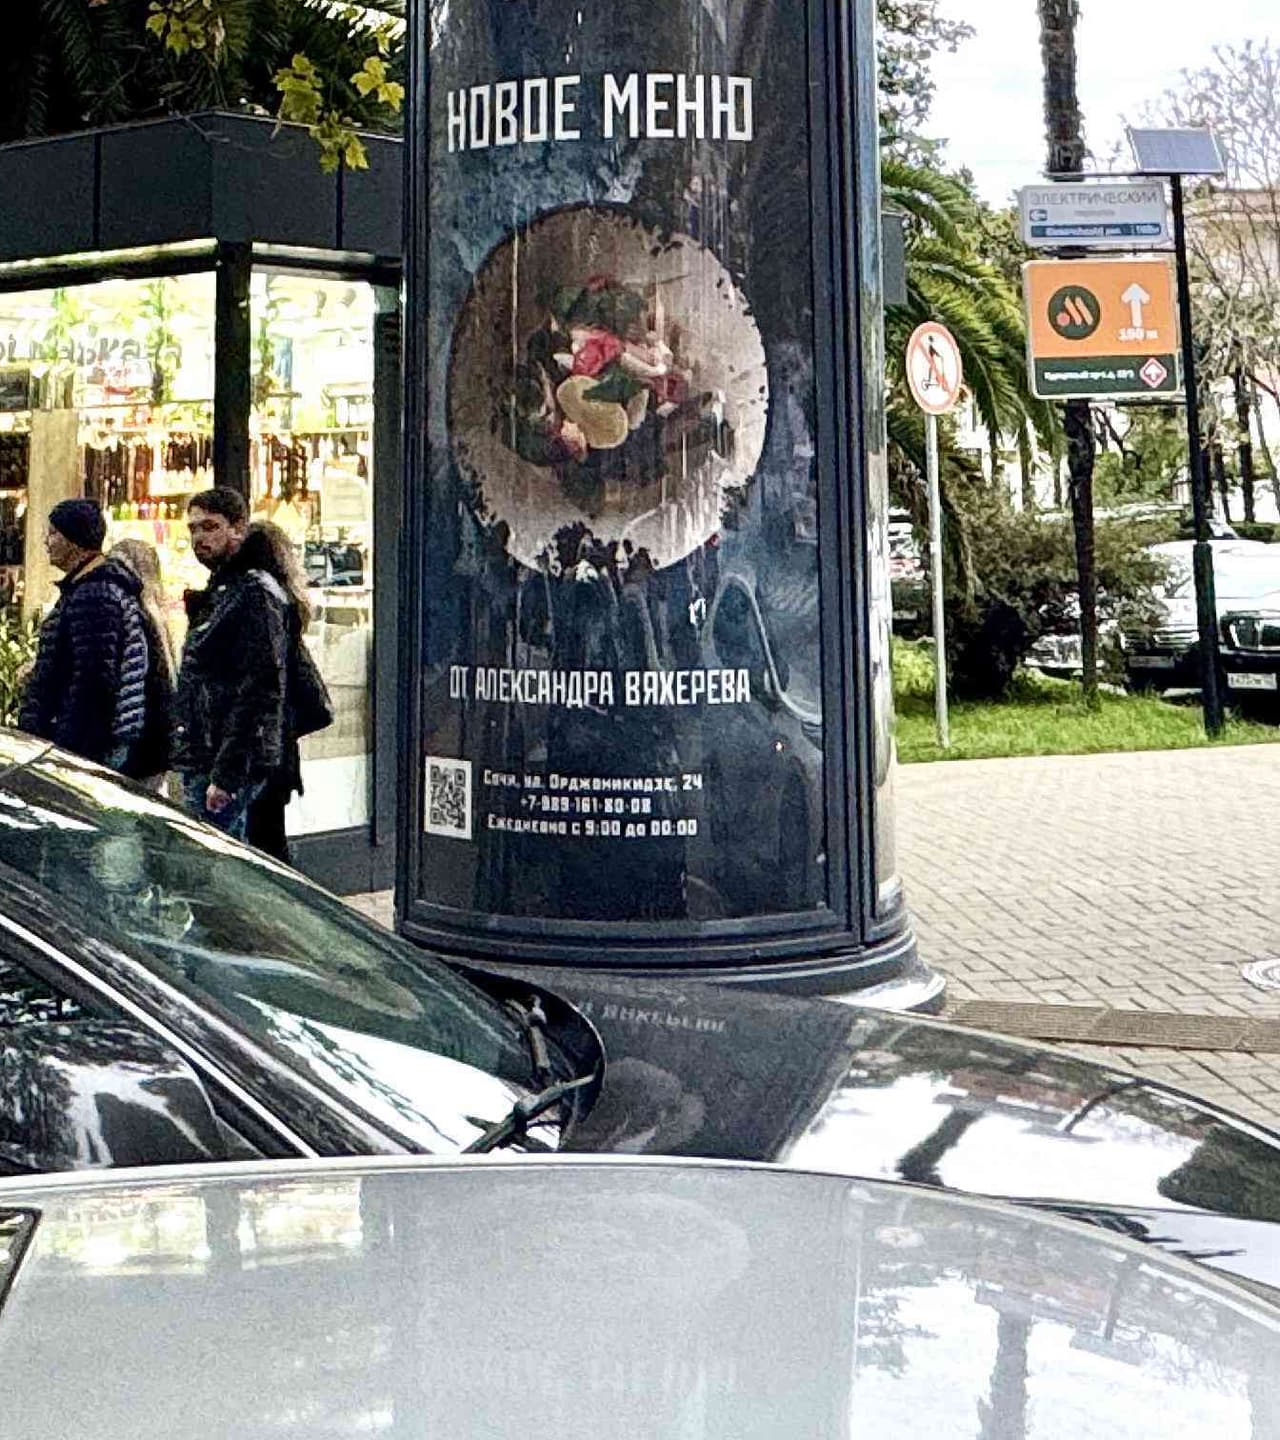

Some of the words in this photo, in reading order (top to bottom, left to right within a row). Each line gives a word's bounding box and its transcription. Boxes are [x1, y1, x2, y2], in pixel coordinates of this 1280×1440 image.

[447, 74, 581, 153] НОВОЕ
[603, 73, 754, 142] МЕНЮ
[448, 665, 470, 701] ОТ
[474, 667, 615, 707] АЛЕКСАНДРА
[624, 667, 751, 706] ВЯХЕРЕВА
[682, 774, 703, 791] 24
[487, 813, 567, 836] Ежедневно
[571, 823, 580, 835] с
[624, 823, 646, 838] до
